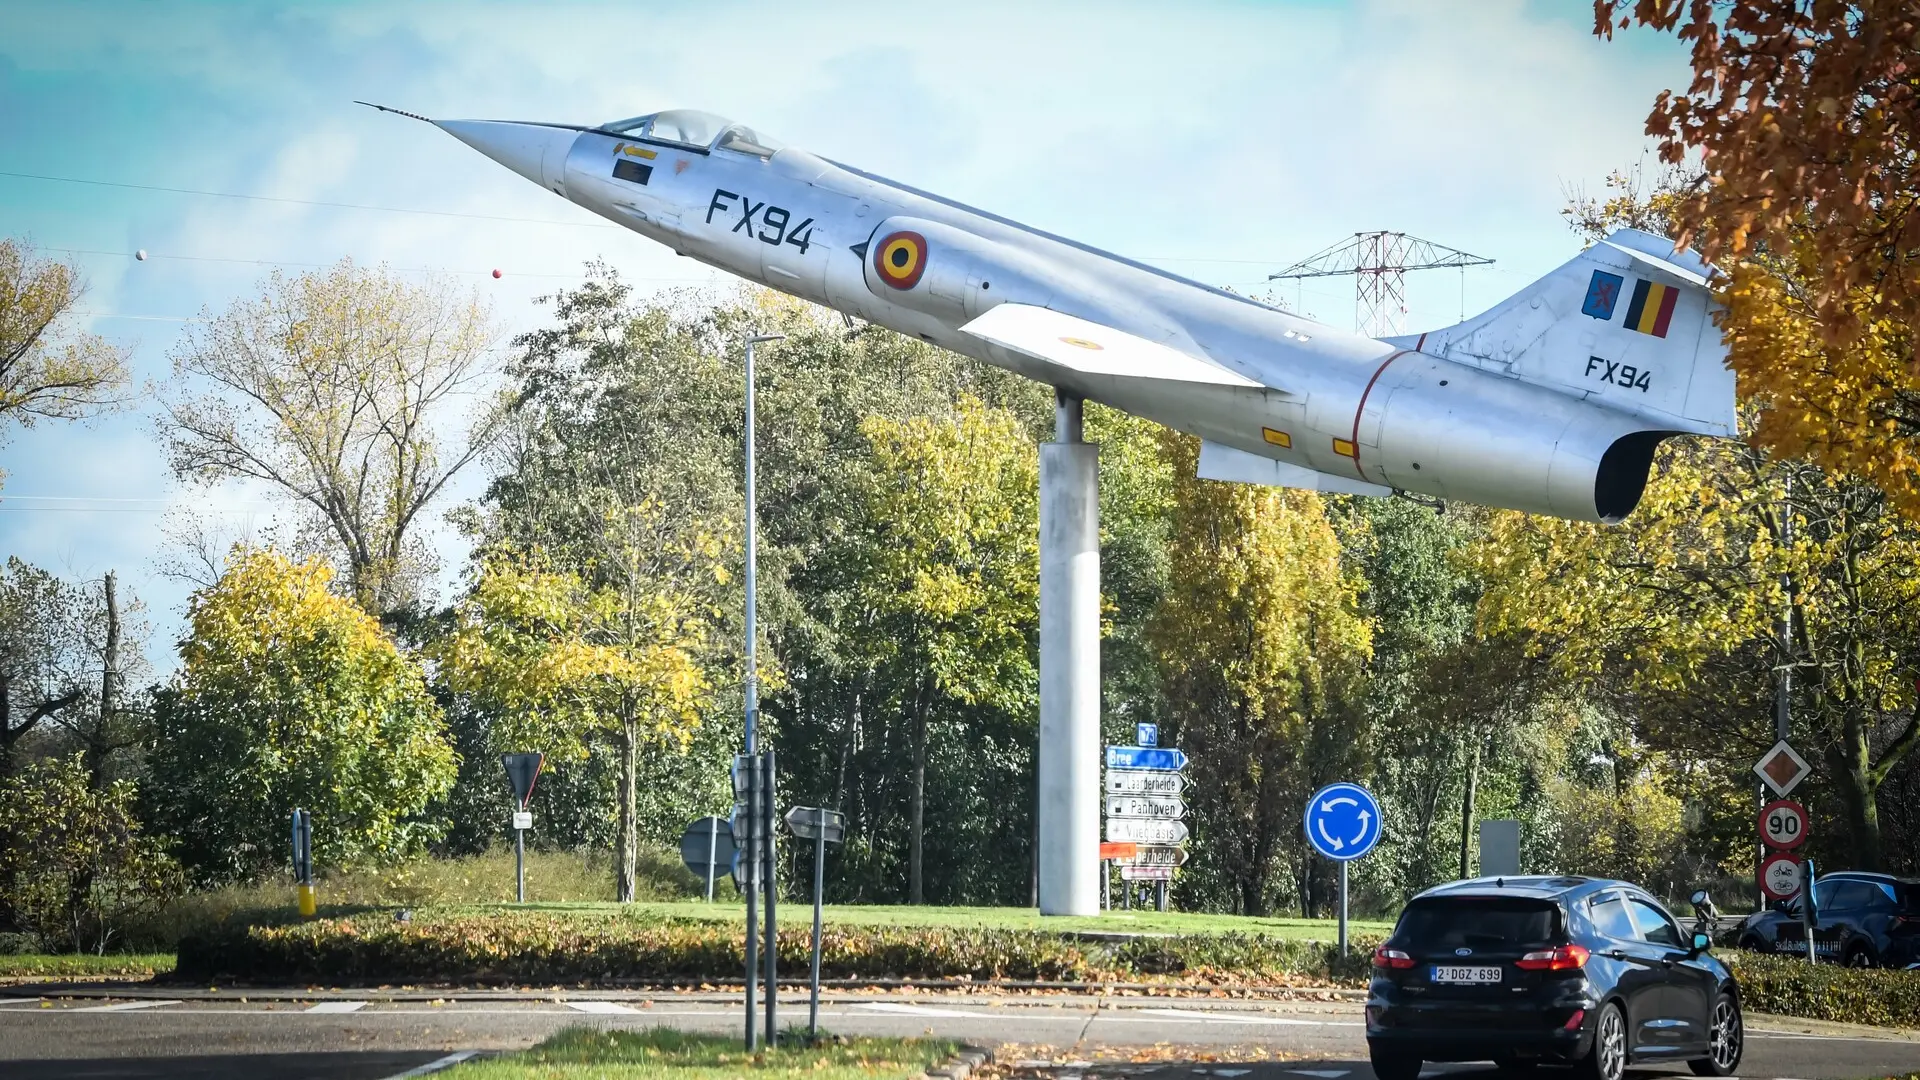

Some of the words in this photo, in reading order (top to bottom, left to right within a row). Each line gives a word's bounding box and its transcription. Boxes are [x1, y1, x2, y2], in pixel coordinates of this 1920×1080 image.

[705, 188, 815, 255] FX94
[1584, 355, 1651, 393] FX94
[1109, 749, 1132, 766] Bree
[1126, 775, 1176, 791] Laarderheide
[1131, 800, 1176, 815] Panhoven
[1769, 815, 1798, 835] 90
